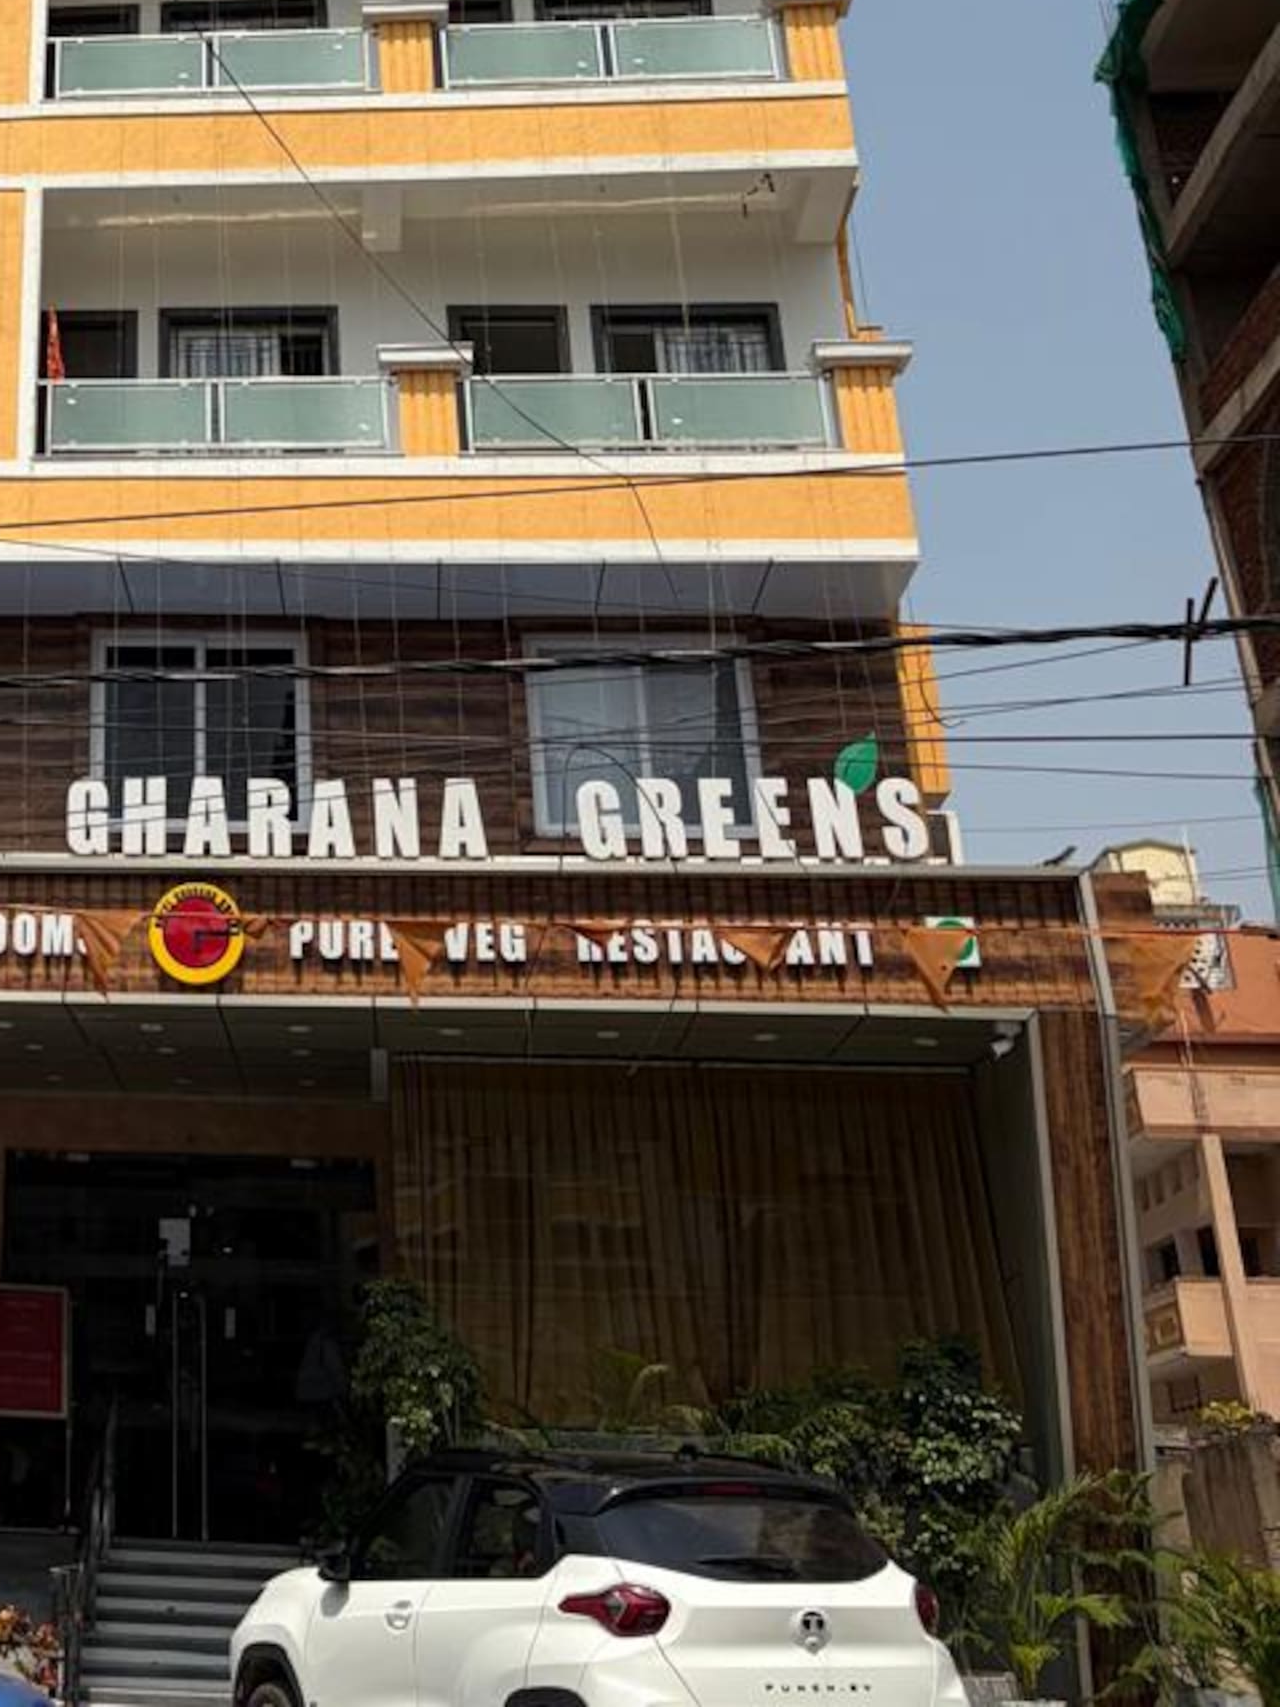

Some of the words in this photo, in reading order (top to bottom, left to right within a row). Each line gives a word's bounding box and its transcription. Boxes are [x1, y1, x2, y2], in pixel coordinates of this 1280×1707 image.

[66, 776, 488, 857] GHARANA
[576, 778, 930, 861] GREENS
[289, 920, 400, 961] PURE
[444, 922, 527, 962] VEG
